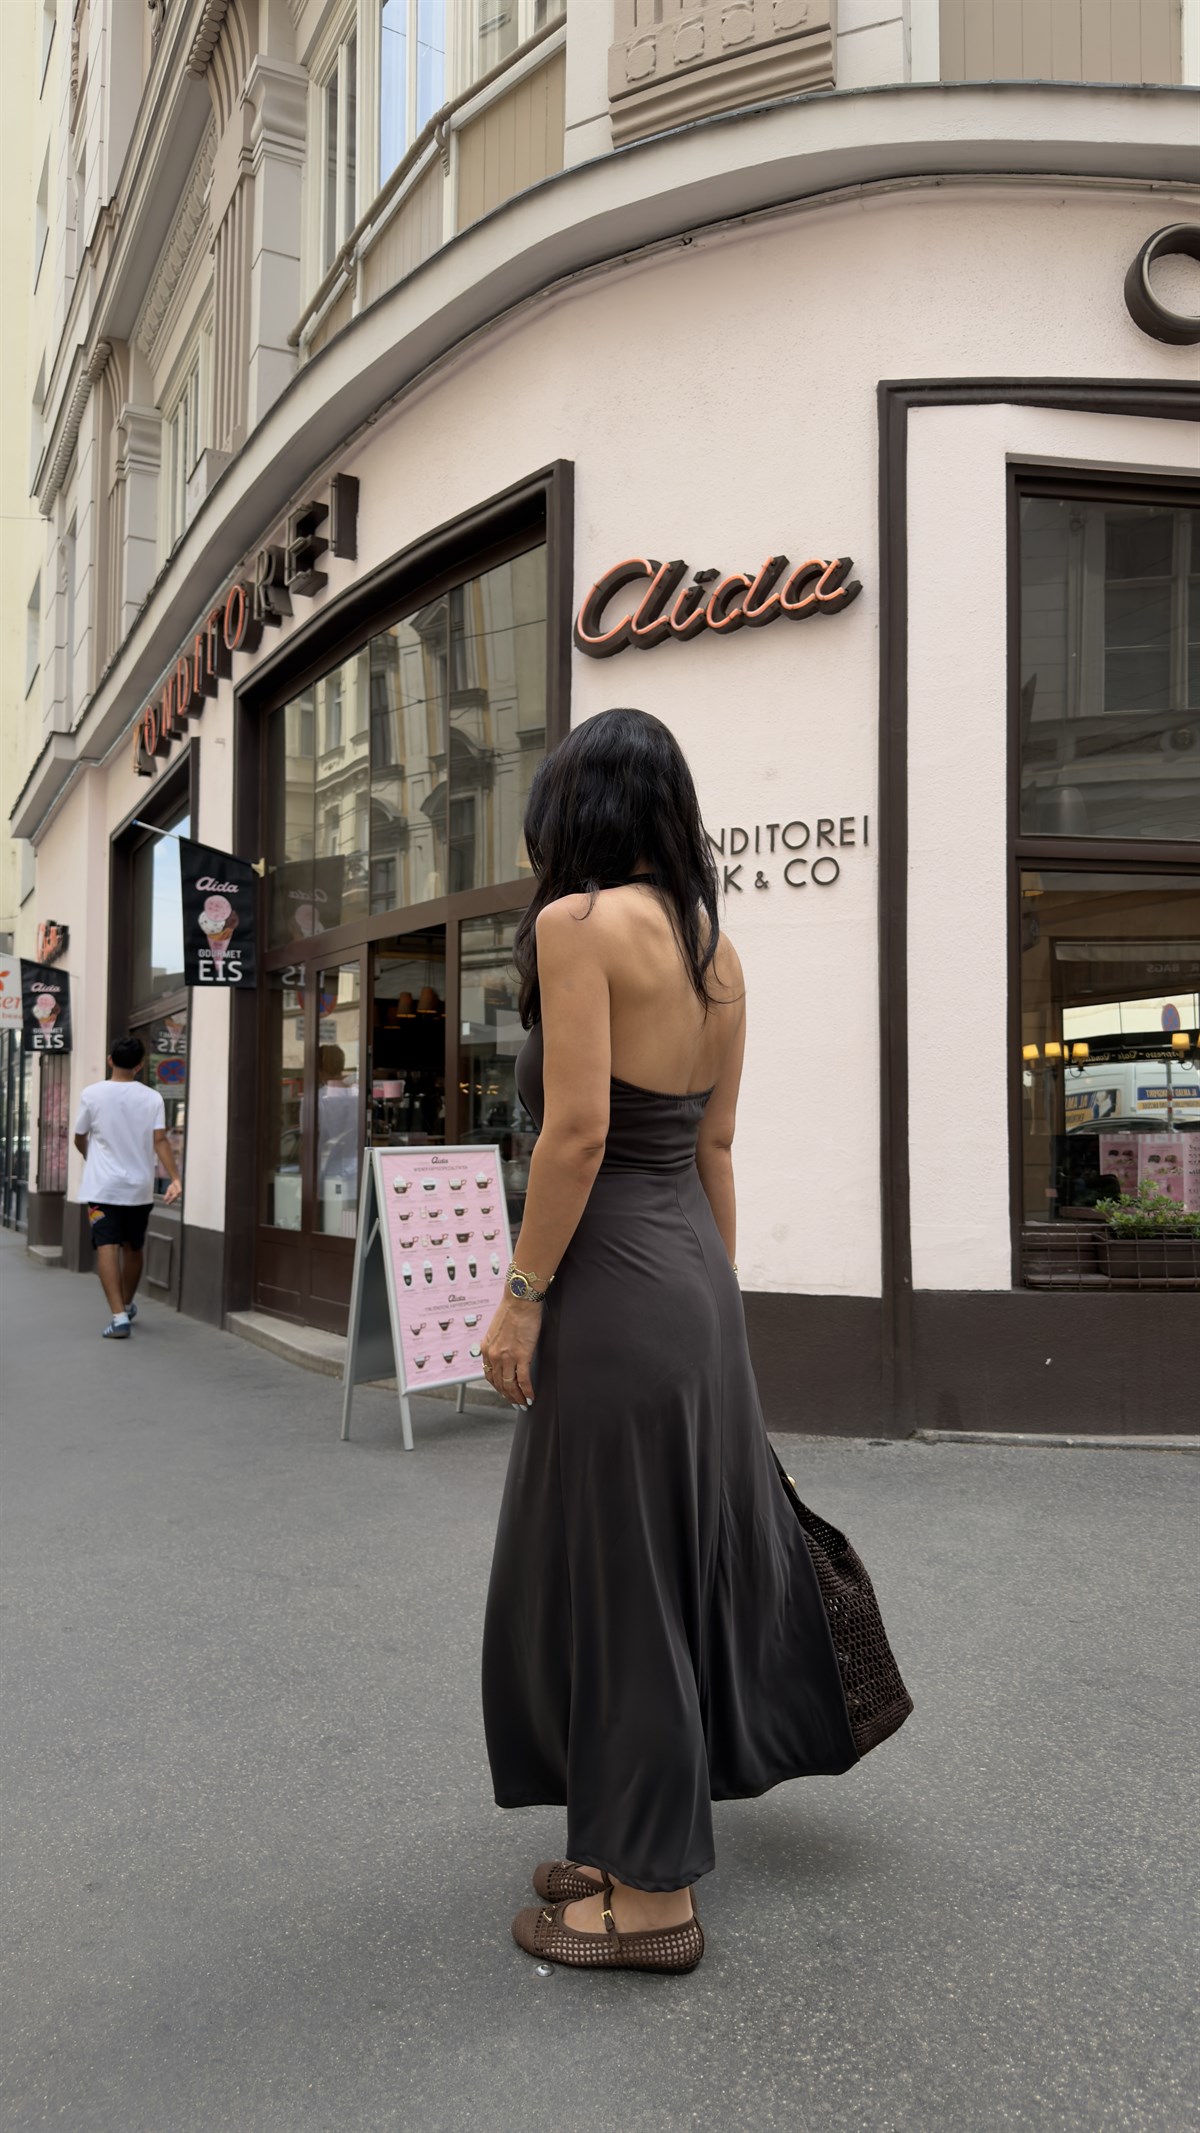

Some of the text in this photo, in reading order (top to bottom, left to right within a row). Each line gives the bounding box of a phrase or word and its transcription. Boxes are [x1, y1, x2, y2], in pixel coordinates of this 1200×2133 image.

[574, 555, 863, 659] Aida
[706, 815, 869, 856] NDITOREI
[195, 876, 239, 894] Aida
[754, 870, 769, 890] &
[783, 856, 840, 888] CO
[199, 960, 243, 982] EIS
[33, 1035, 64, 1049] EIS
